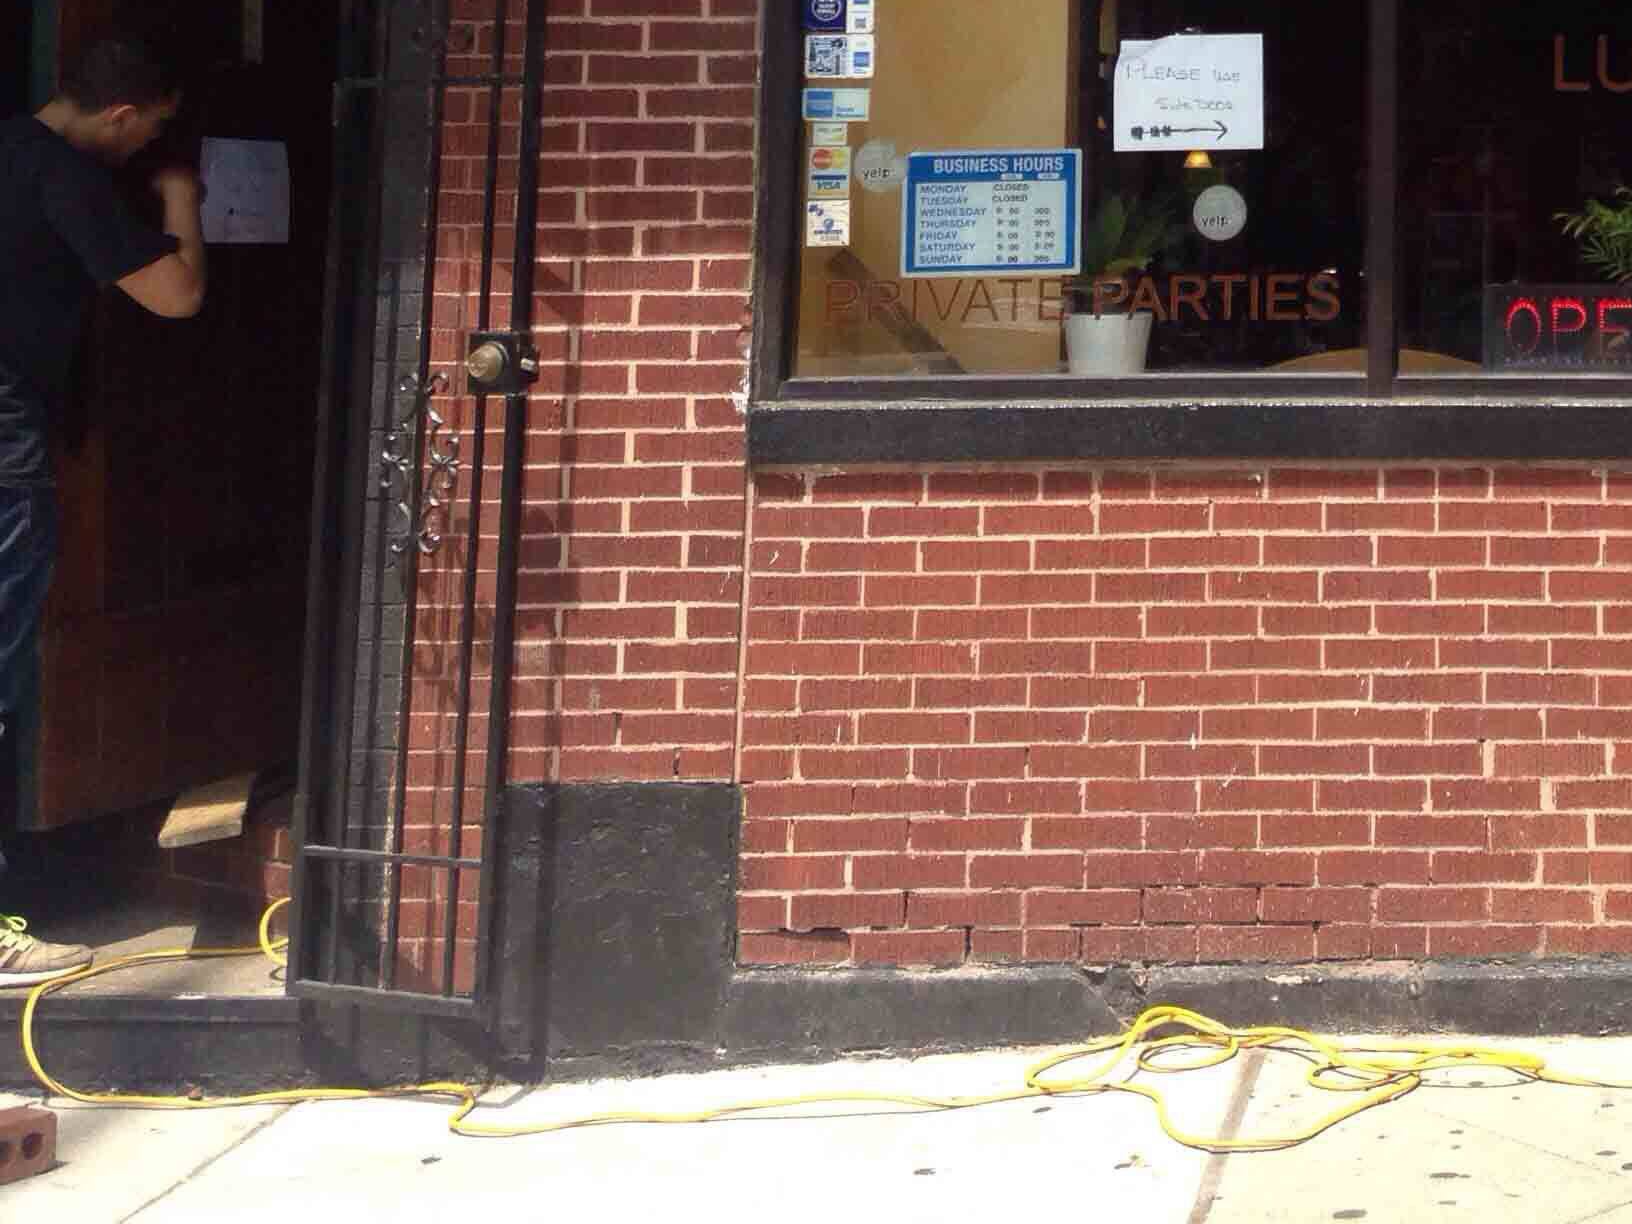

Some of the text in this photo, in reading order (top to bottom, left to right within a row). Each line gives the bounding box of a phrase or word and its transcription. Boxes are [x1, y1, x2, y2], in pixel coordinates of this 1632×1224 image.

[933, 156, 1064, 174] BUSINESS HOURS
[919, 185, 967, 194] MONDAY
[920, 196, 968, 206] TUESDAY
[920, 207, 987, 218] WEDNESDAY
[919, 232, 958, 241] FRIDAY
[919, 255, 963, 265] SUNDAY
[822, 273, 1340, 324] PRIVATE PARTIES
